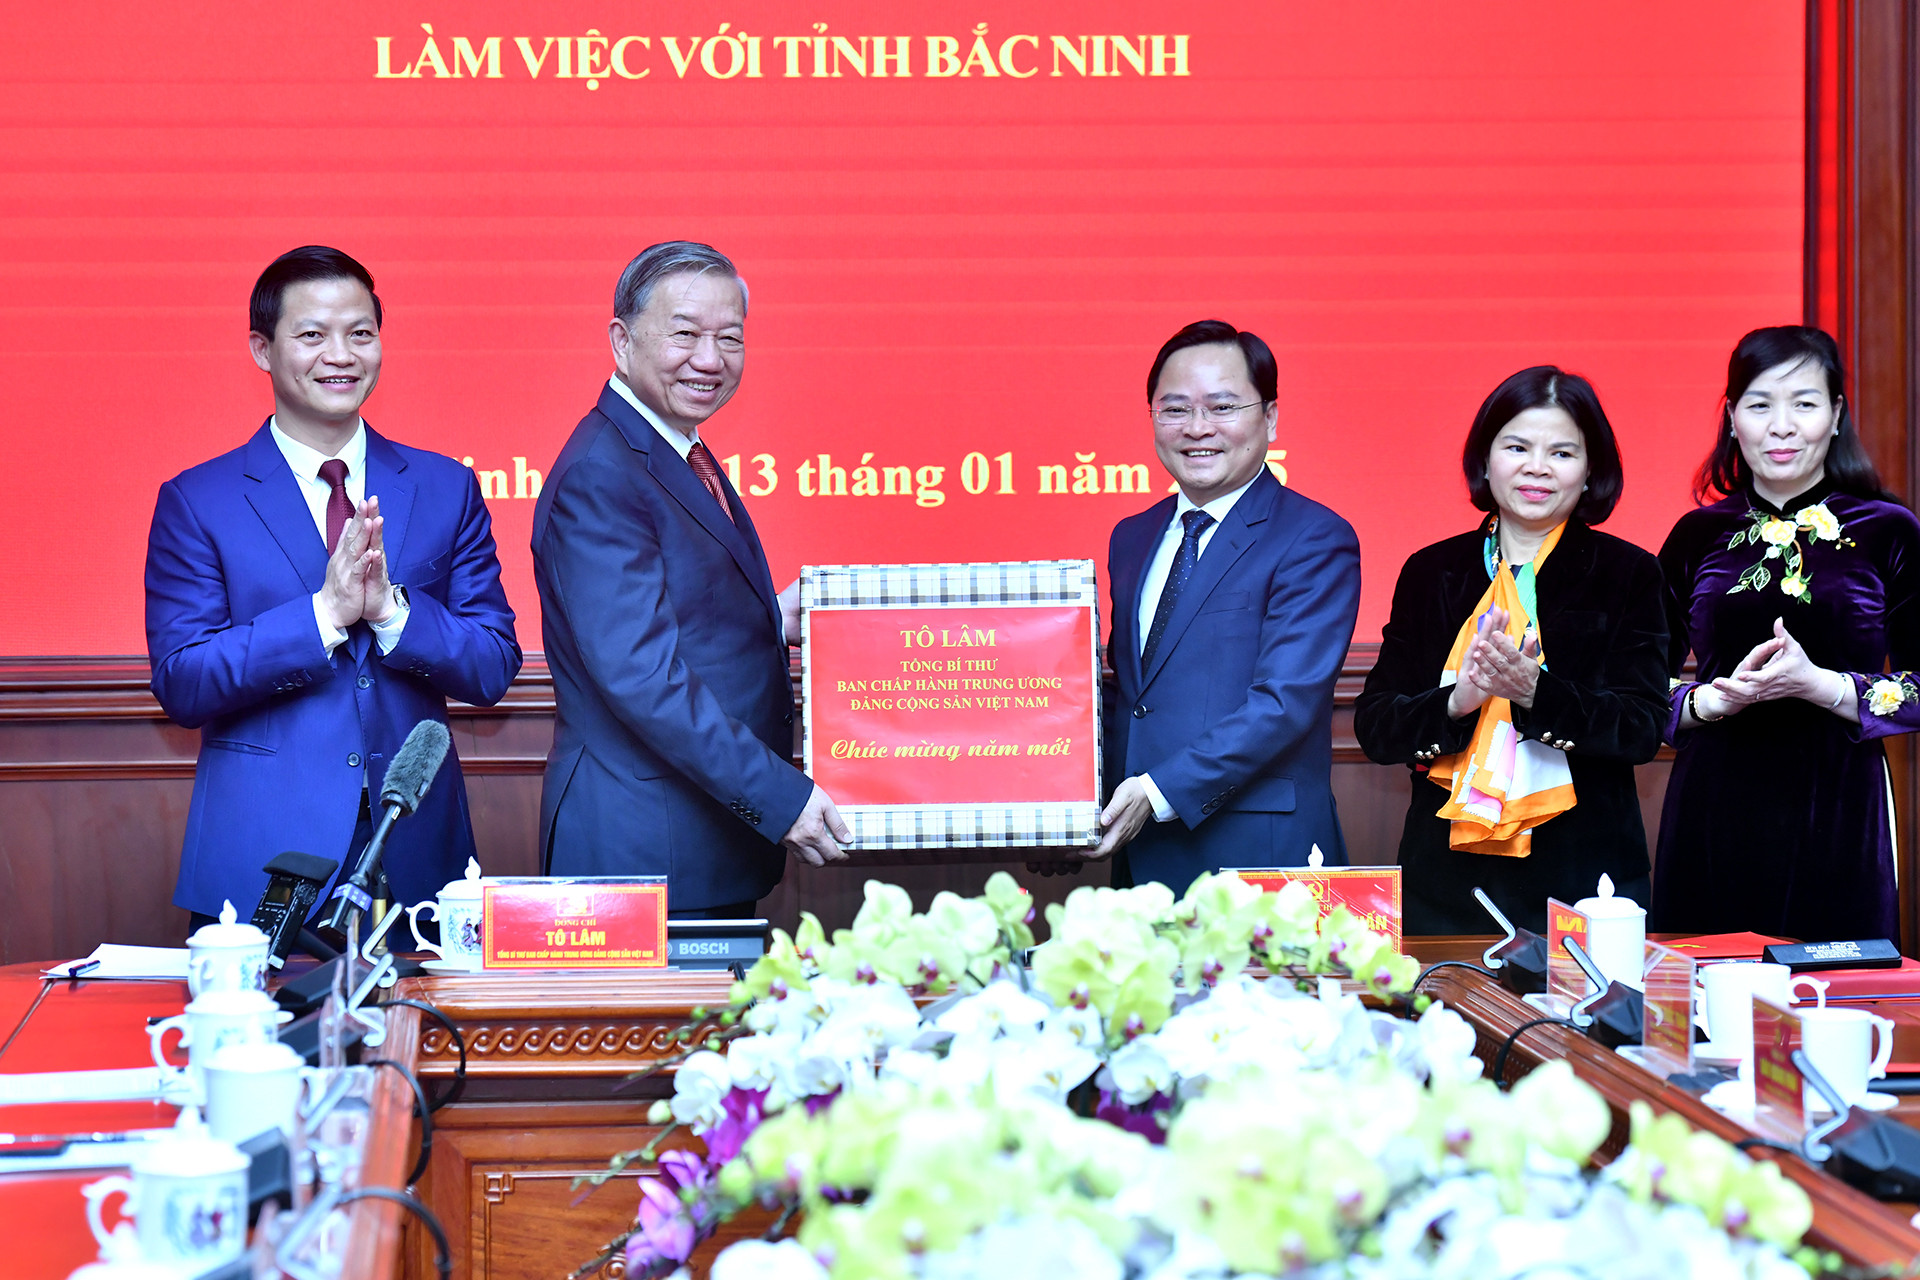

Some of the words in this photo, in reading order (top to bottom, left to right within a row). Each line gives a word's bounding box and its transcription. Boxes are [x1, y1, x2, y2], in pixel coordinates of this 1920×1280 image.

[375, 23, 503, 79] LÀM
[514, 29, 650, 90] VIỆC
[661, 23, 762, 80] VỚI
[774, 23, 912, 78] TỈNH
[925, 22, 1038, 78] BẮC
[1050, 35, 1190, 77] NINH
[722, 453, 778, 497] 13
[796, 453, 945, 507] tháng
[961, 452, 1015, 495] 01
[1038, 452, 1150, 494] năm
[900, 625, 935, 648] TÔ
[941, 624, 996, 647] LÂM
[900, 656, 942, 672] TỔNG
[947, 656, 961, 672] BÍ
[965, 658, 998, 672] THƯ
[837, 680, 866, 692] BAN
[871, 676, 911, 692] CHẤP
[916, 676, 958, 691] HÀNH
[962, 678, 1014, 690] TRUNG
[1018, 676, 1062, 690] ƯƠNG
[850, 696, 892, 711] ĐẢNG
[897, 697, 939, 713] CỘNG
[943, 696, 972, 710] SẢN
[976, 695, 1011, 711] VIỆT
[1015, 697, 1049, 708] NAM
[831, 739, 888, 759] Chúc
[894, 740, 961, 762] mừng
[968, 739, 1021, 757] năm
[1027, 738, 1072, 756] mới
[545, 928, 566, 946] TÔ
[571, 928, 606, 946] LÂM
[679, 942, 729, 955] BOSCH
